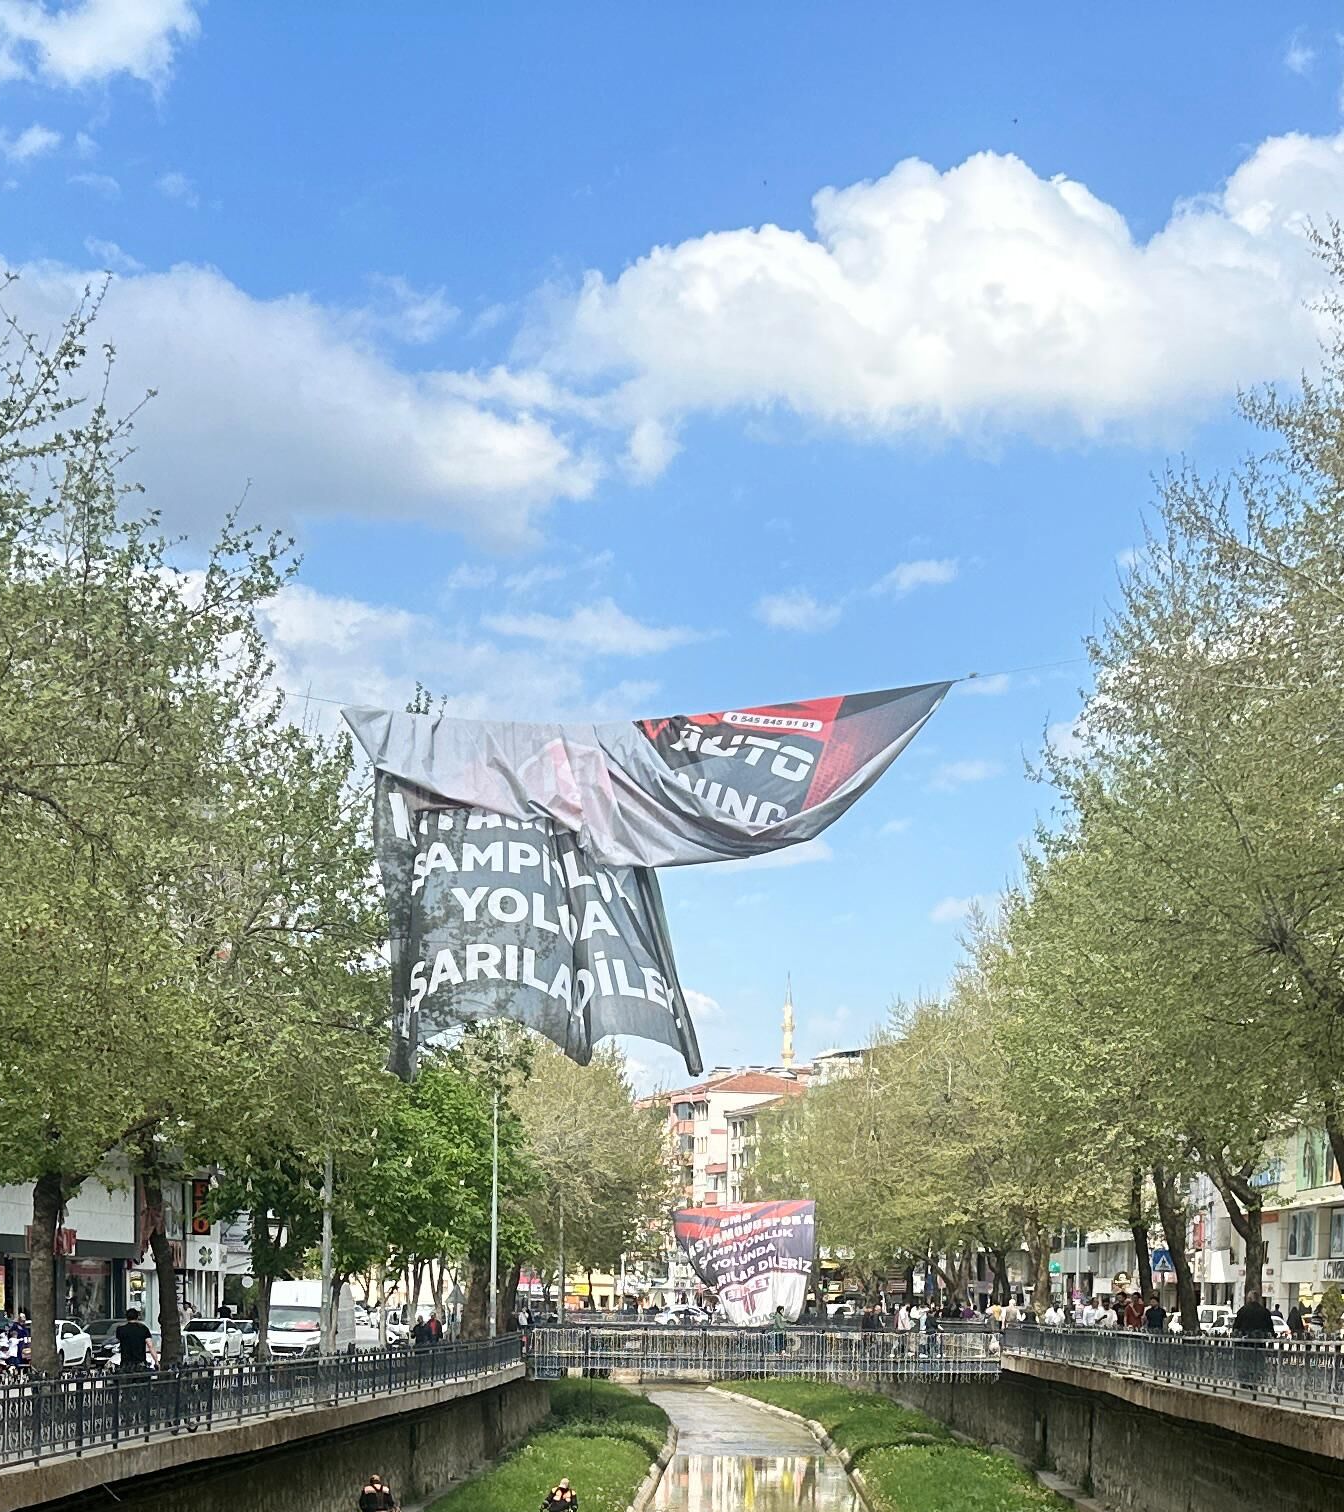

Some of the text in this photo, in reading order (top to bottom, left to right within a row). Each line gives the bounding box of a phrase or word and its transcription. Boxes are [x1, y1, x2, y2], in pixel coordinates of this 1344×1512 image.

[730, 714, 738, 722] 0
[740, 715, 760, 725] 545
[785, 719, 798, 727] 91
[712, 1242, 777, 1272] YOLUNDA
[758, 1255, 813, 1274] DİLERİZ
